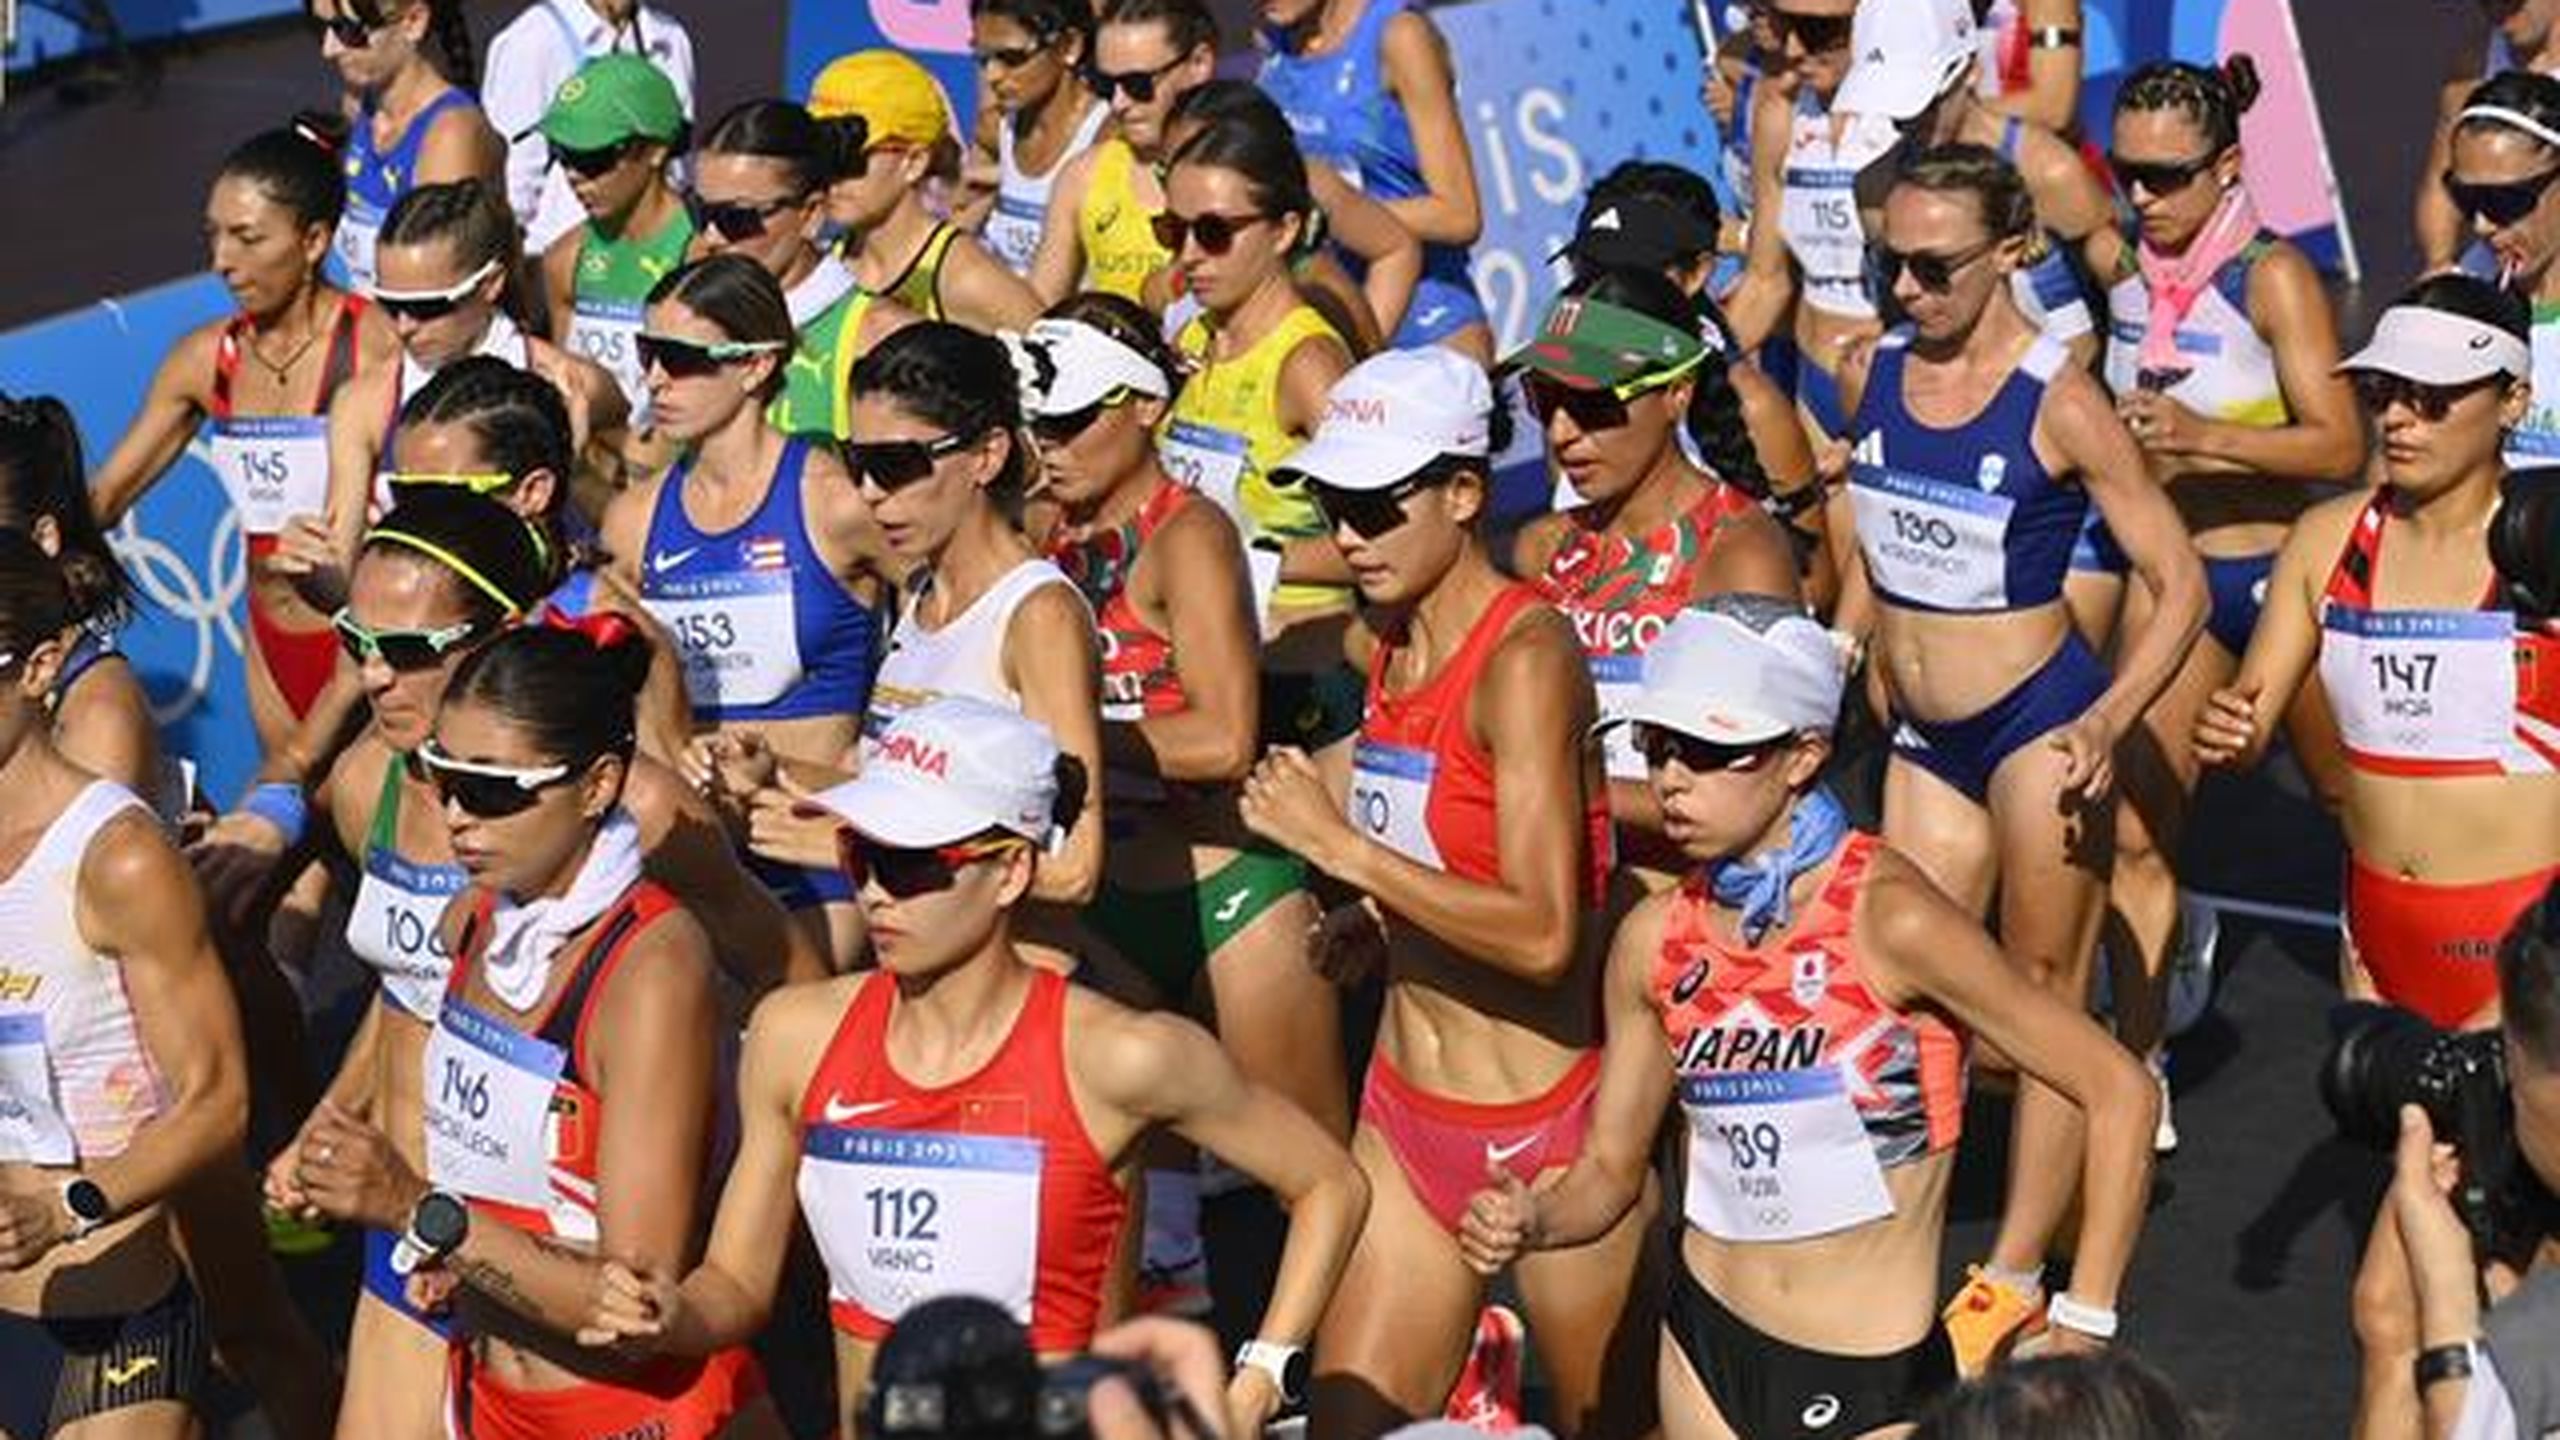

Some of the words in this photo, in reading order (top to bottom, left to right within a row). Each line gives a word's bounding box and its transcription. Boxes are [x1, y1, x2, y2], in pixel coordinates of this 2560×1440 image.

[240, 450, 289, 484] 145
[1889, 508, 1957, 550] 130
[675, 611, 736, 651] 153
[2371, 654, 2438, 692] 147
[1676, 1027, 1825, 1071] JAPAN
[441, 1057, 490, 1119] 146
[1718, 1122, 1781, 1169] 139
[866, 1187, 938, 1240] 112
